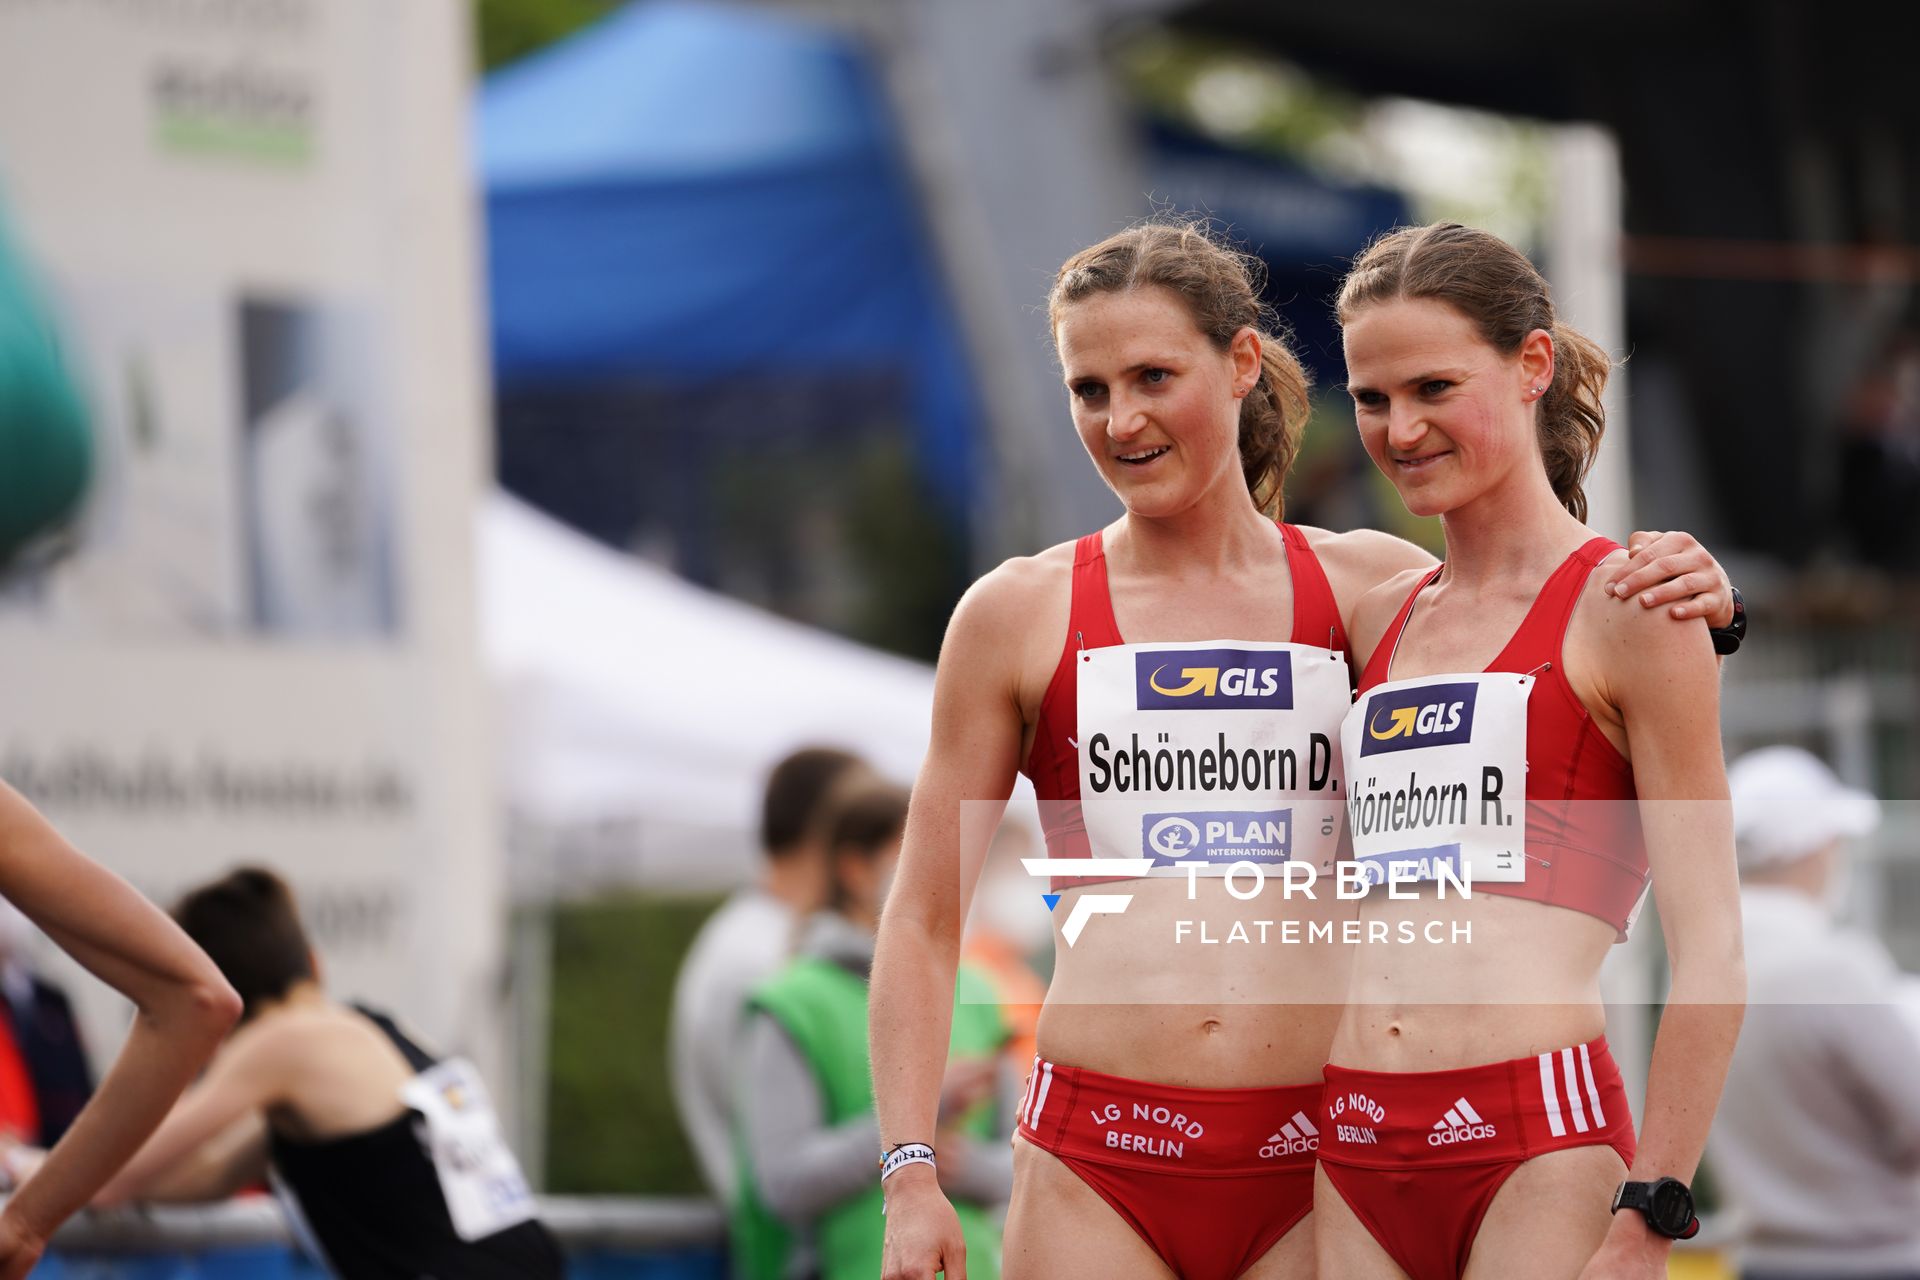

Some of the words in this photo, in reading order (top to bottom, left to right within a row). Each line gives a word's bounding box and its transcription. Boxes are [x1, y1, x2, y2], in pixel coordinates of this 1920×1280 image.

[1219, 667, 1278, 697] GLS
[1416, 701, 1465, 735] GLS
[1089, 732, 1297, 793] Schöneborn
[1308, 732, 1338, 792] D.
[1348, 771, 1468, 838] höneborn
[1480, 765, 1513, 827] R.
[1205, 820, 1286, 845] PLAN
[1320, 815, 1335, 837] 10
[1206, 847, 1286, 857] INTERNATIONAL
[1090, 1103, 1122, 1125] LG
[1132, 1103, 1204, 1140] NORD
[1329, 1096, 1345, 1120] LG
[1348, 1092, 1386, 1124] NORD
[1105, 1130, 1184, 1159] BERLIN
[1258, 1136, 1320, 1159] adida
[1336, 1124, 1378, 1145] BERLIN
[1427, 1123, 1497, 1147] adidas
